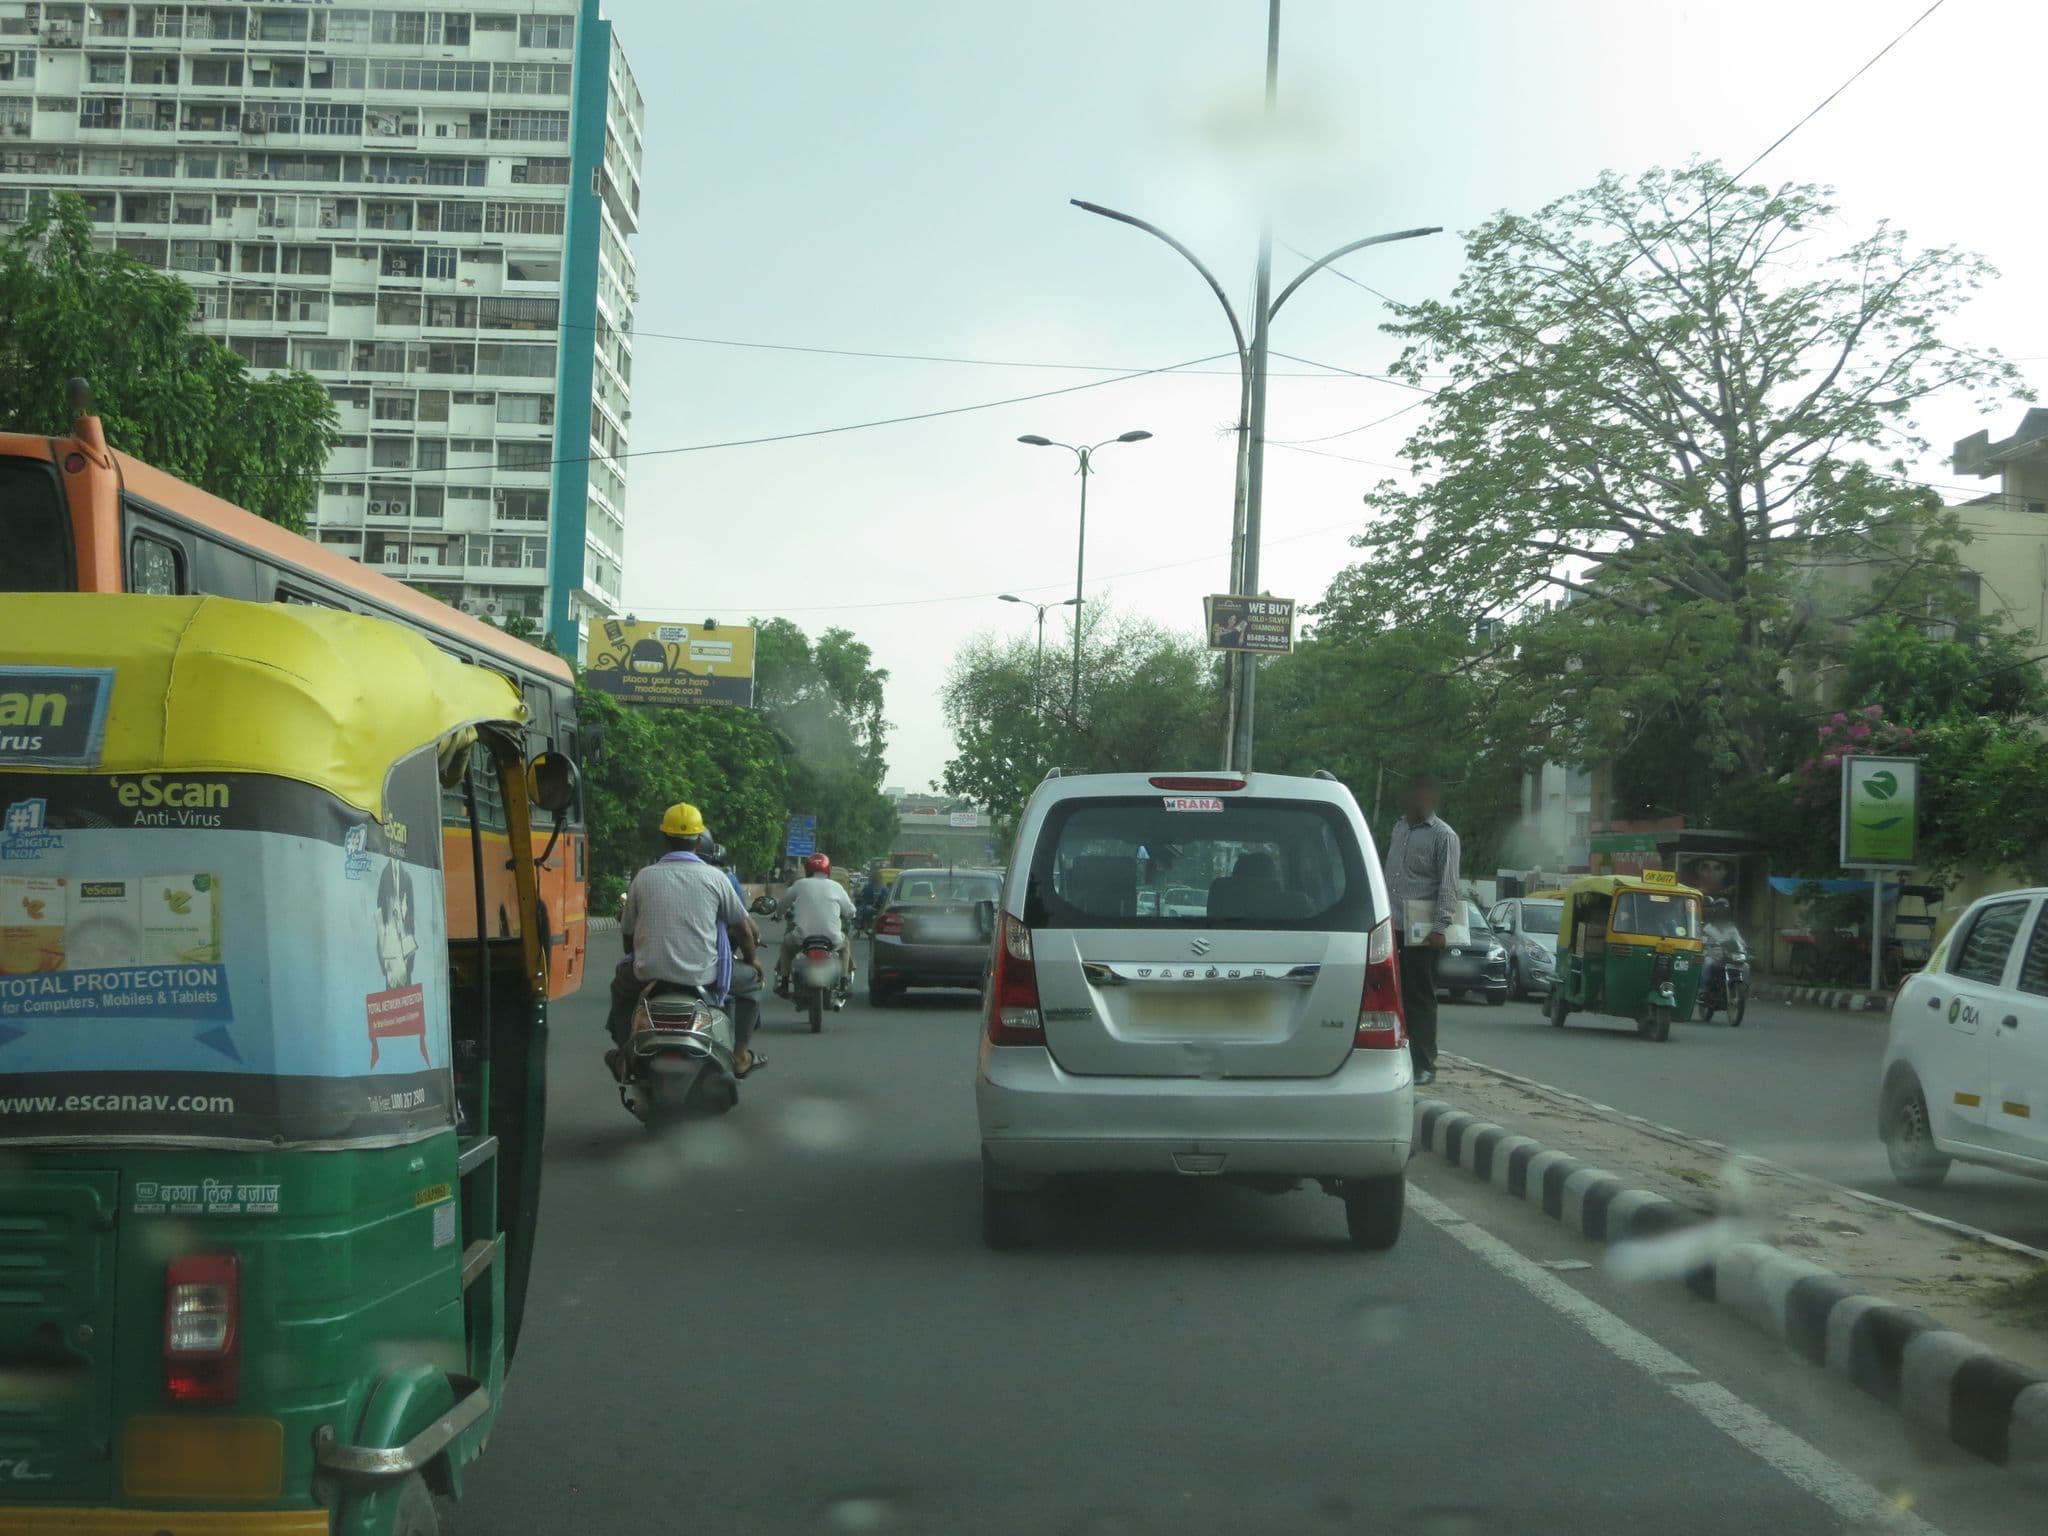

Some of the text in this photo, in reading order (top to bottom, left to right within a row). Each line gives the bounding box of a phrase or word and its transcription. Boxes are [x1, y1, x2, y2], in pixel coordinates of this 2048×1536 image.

[1248, 602, 1265, 614] WE
[1268, 603, 1290, 615] BUY
[1248, 615, 1265, 623] GOLD
[1177, 799, 1222, 809] RANA
[10, 802, 41, 834] #1
[134, 809, 222, 827] Anti-Virus
[0, 968, 218, 997] TOTAL PROTECTION
[3, 988, 218, 1015] for Computers, Mobiles & Tablets
[1962, 1005, 1980, 1026] OLA
